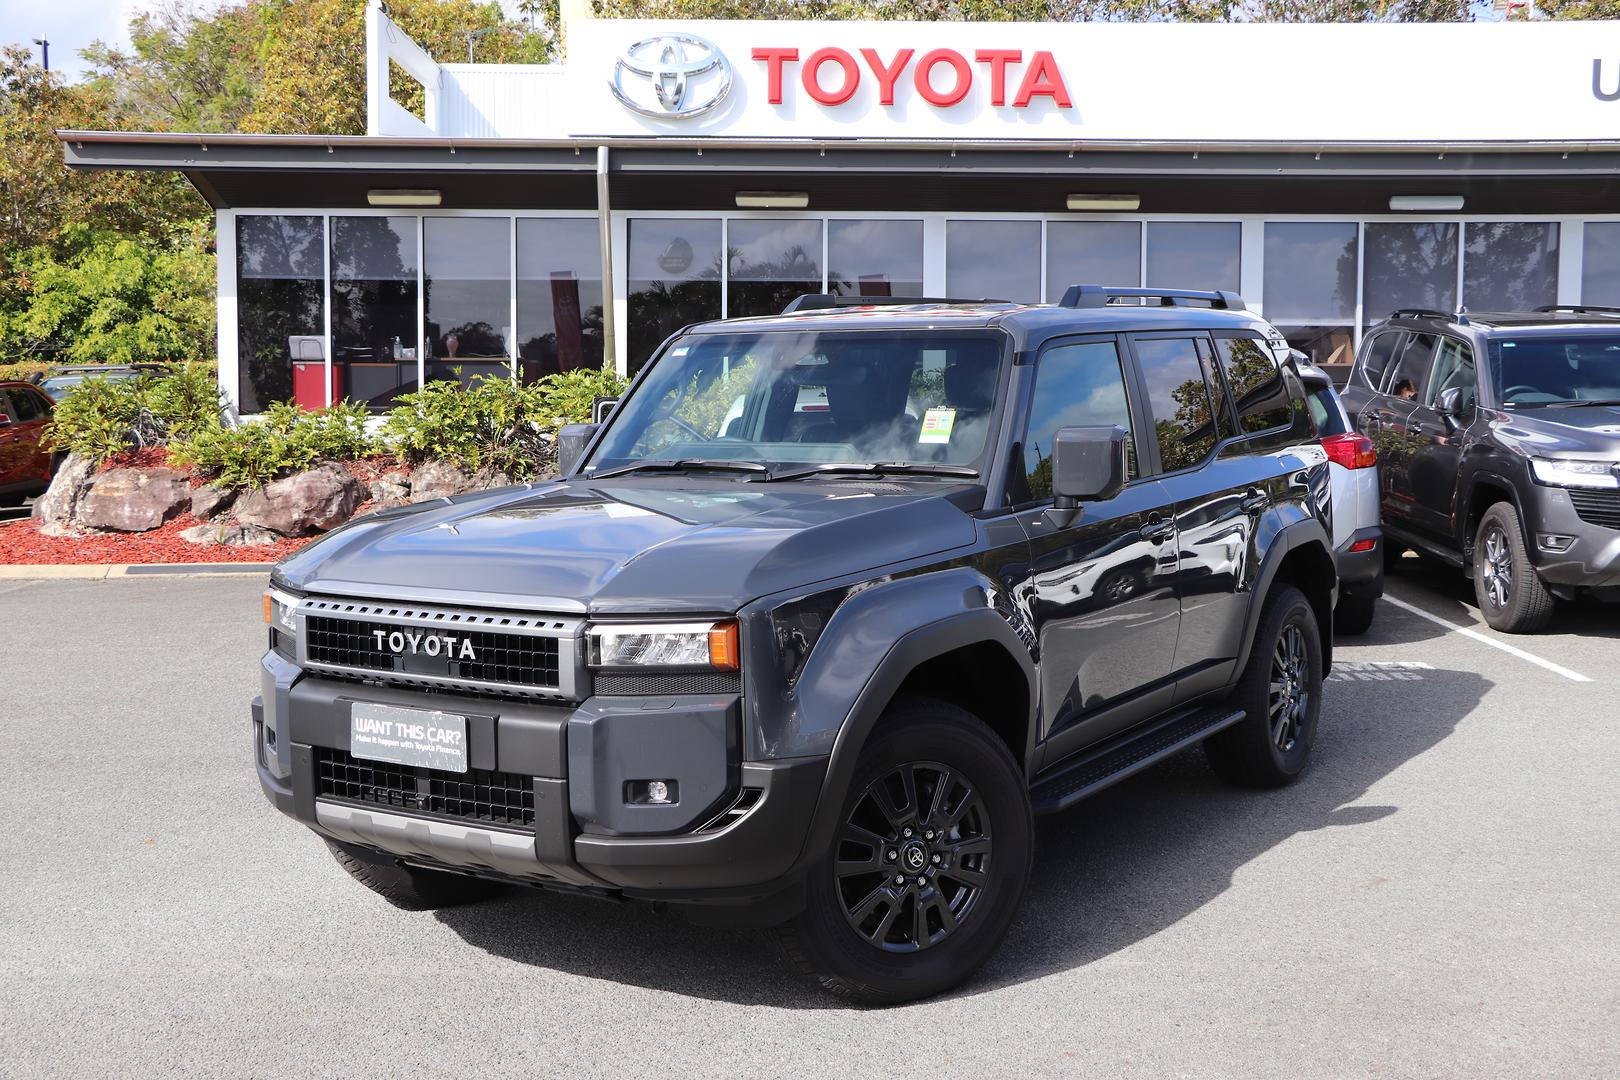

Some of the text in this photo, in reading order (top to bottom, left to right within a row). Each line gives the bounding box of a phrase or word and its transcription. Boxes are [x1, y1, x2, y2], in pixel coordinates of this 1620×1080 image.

[751, 47, 1073, 108] TOYOTA
[373, 630, 476, 660] TOYOTA
[355, 717, 462, 745] WANT THIS CAR?
[355, 734, 371, 743] Make
[378, 737, 399, 748] happen
[400, 740, 414, 749] with
[415, 742, 435, 752] Toyota
